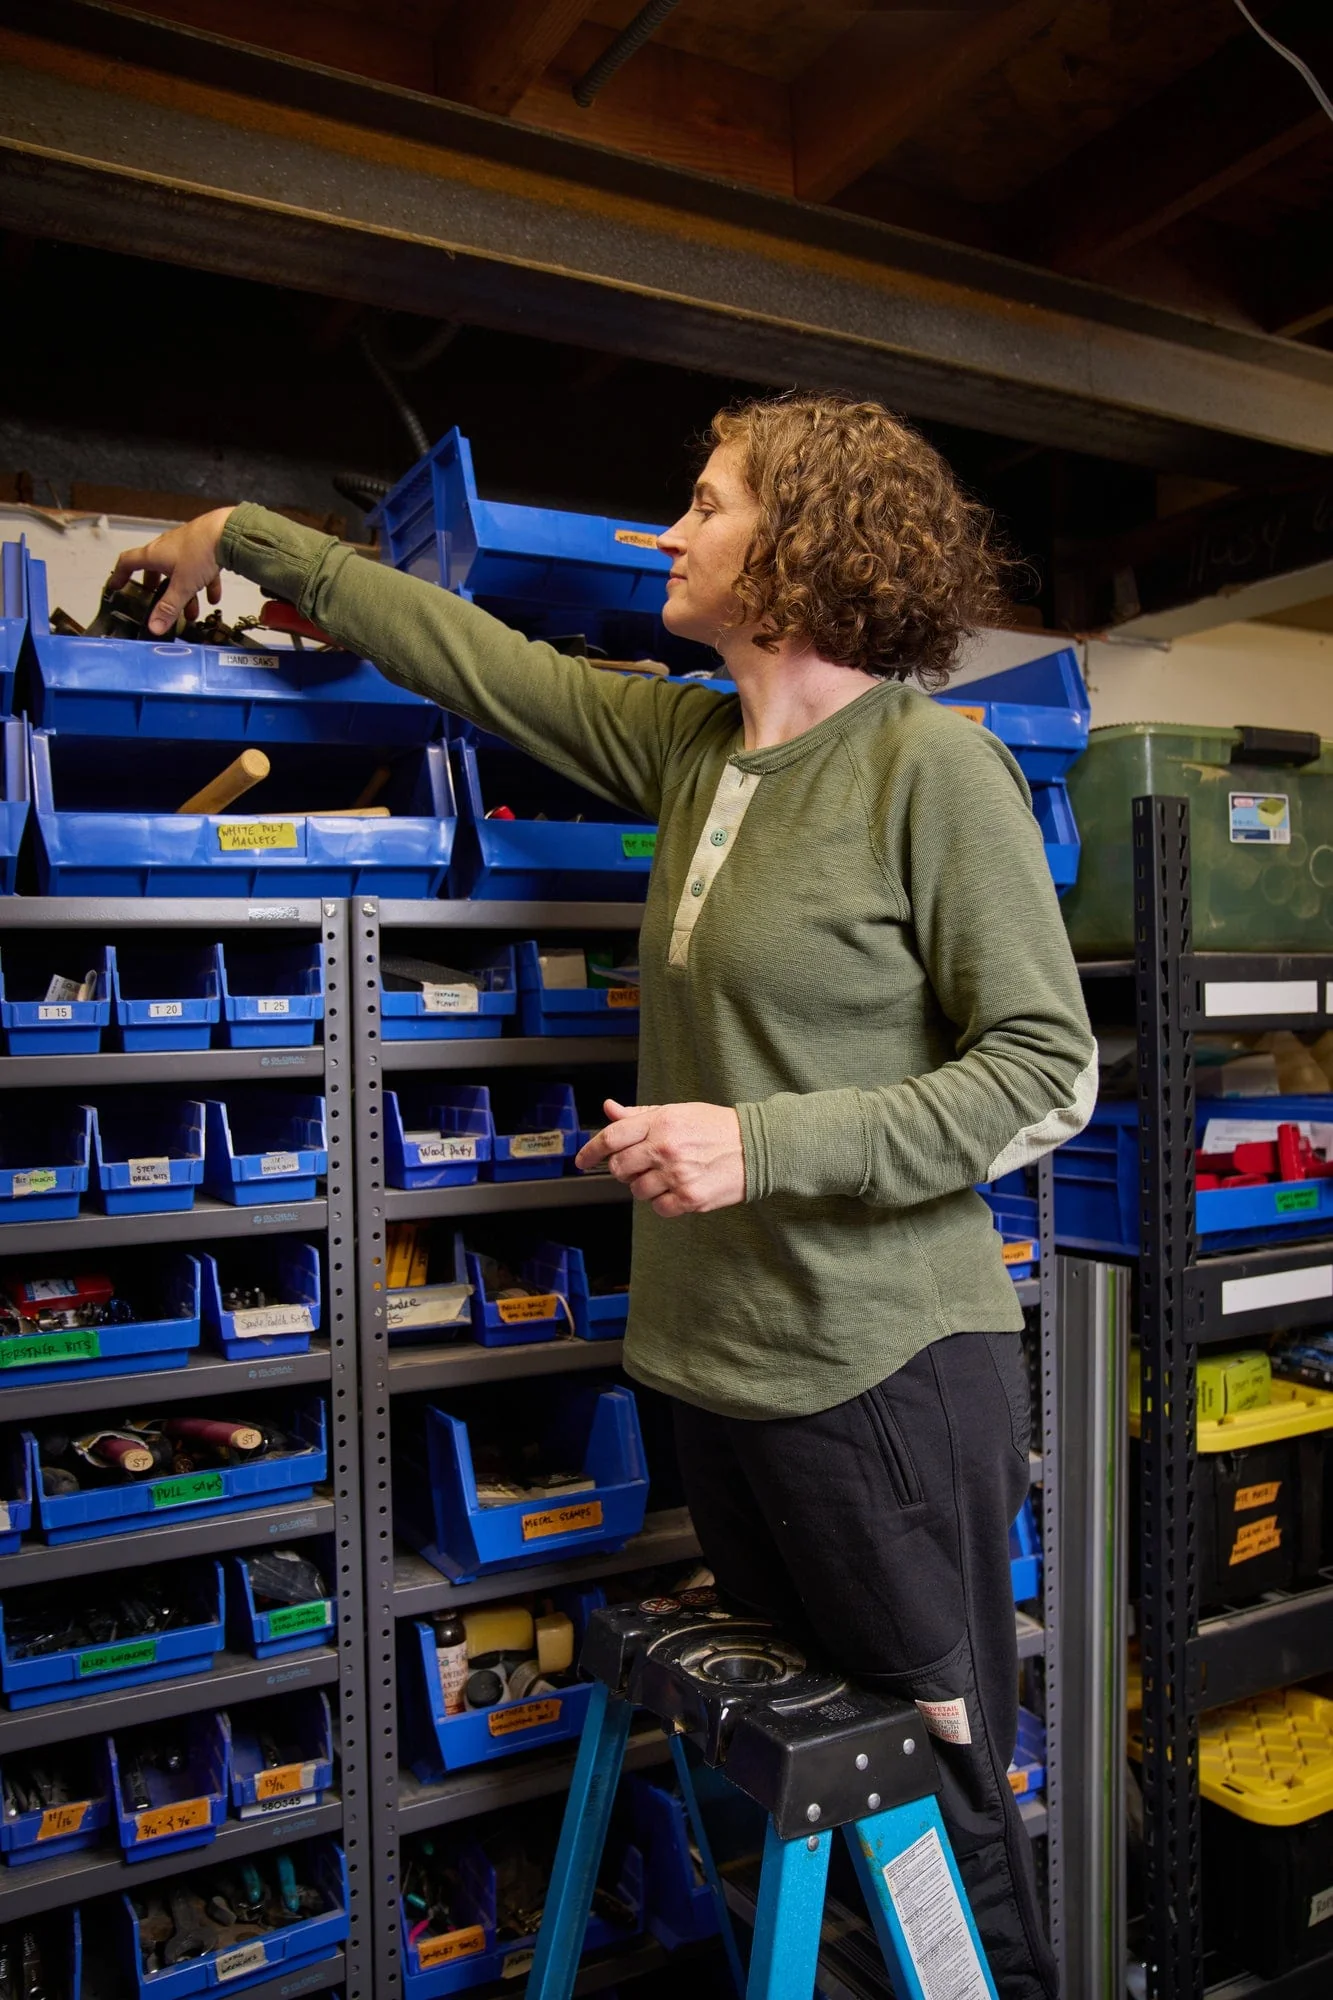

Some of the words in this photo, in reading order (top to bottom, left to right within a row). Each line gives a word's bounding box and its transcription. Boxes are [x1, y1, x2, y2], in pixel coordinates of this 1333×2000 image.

[227, 656, 249, 667] HAND
[253, 657, 275, 667] SAWS
[222, 826, 254, 839] WHITE
[231, 836, 277, 847] MALLETS
[155, 1005, 160, 1015] T
[166, 1005, 178, 1015] 20
[263, 1001, 268, 1011] T
[273, 1001, 285, 1011] 25
[44, 1008, 49, 1018] T
[56, 1008, 68, 1018] 15
[420, 1143, 445, 1157] Wood
[136, 1165, 156, 1174] STEP
[133, 1175, 151, 1183] DRILL
[154, 1173, 168, 1181] BITS
[65, 1340, 92, 1353] BITS
[157, 1486, 185, 1502] PULL
[193, 1480, 222, 1492] SAWS
[524, 1517, 554, 1531] METAL
[559, 1508, 591, 1522] STAMPS
